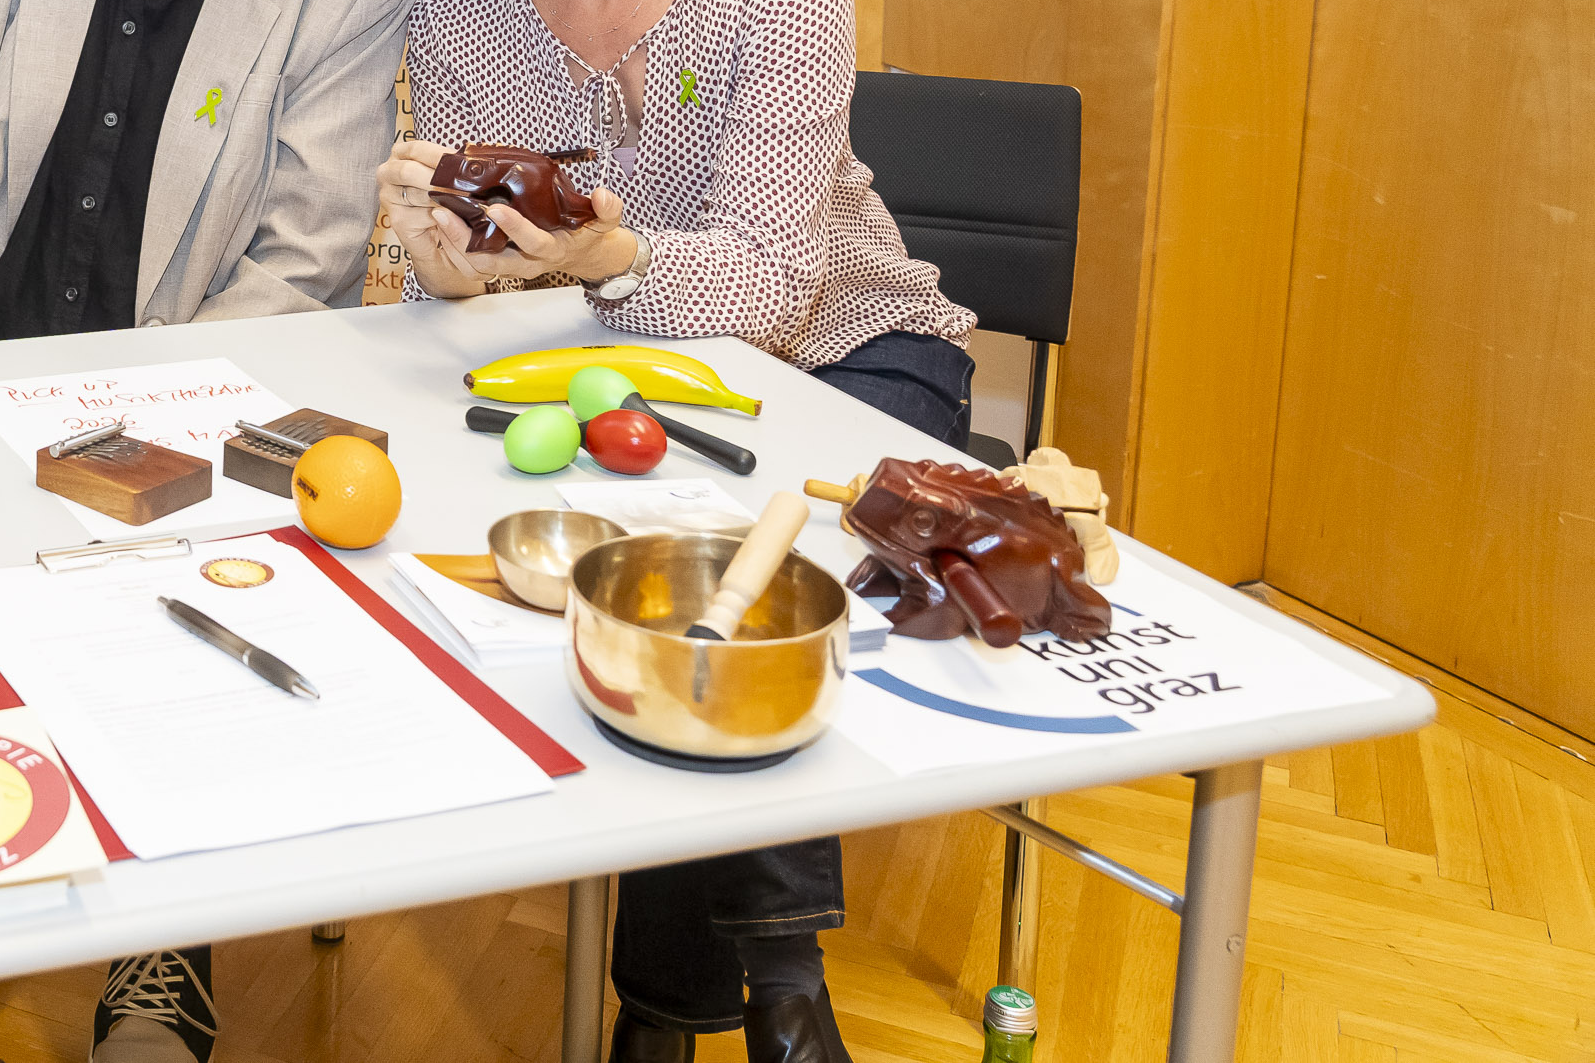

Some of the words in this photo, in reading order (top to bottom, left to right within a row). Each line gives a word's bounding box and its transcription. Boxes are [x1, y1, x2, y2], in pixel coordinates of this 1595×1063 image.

[83, 379, 118, 390] UP
[1017, 621, 1197, 661] kunst
[1056, 655, 1164, 683] uni
[1098, 671, 1244, 715] graz
